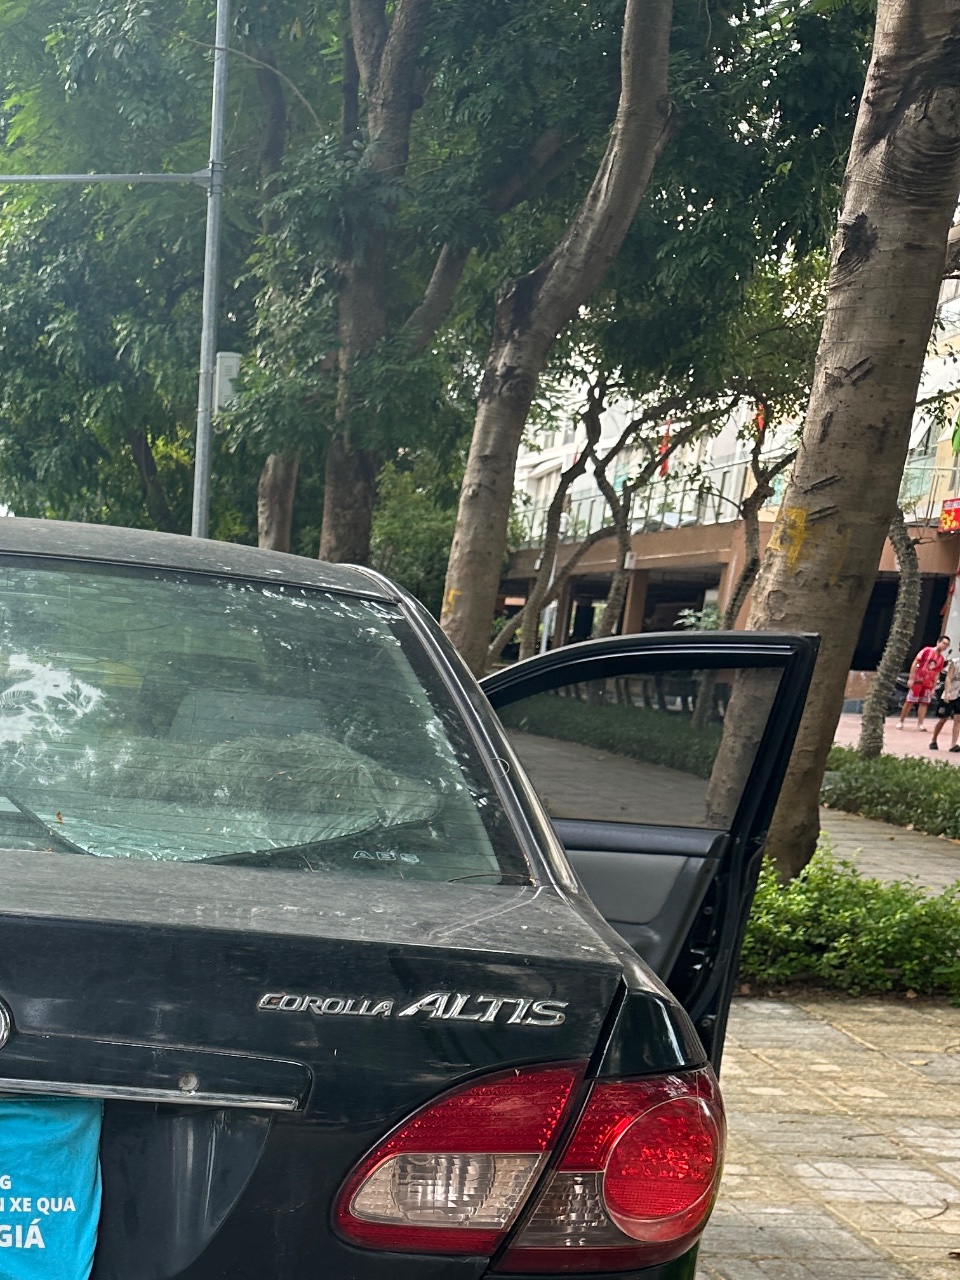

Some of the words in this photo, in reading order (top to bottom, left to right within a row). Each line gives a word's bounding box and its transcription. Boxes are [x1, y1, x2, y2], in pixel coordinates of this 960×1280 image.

[257, 993, 395, 1018] COROLLA
[398, 992, 570, 1027] ALTIS
[9, 1196, 33, 1212] XE
[36, 1197, 76, 1216] QUA
